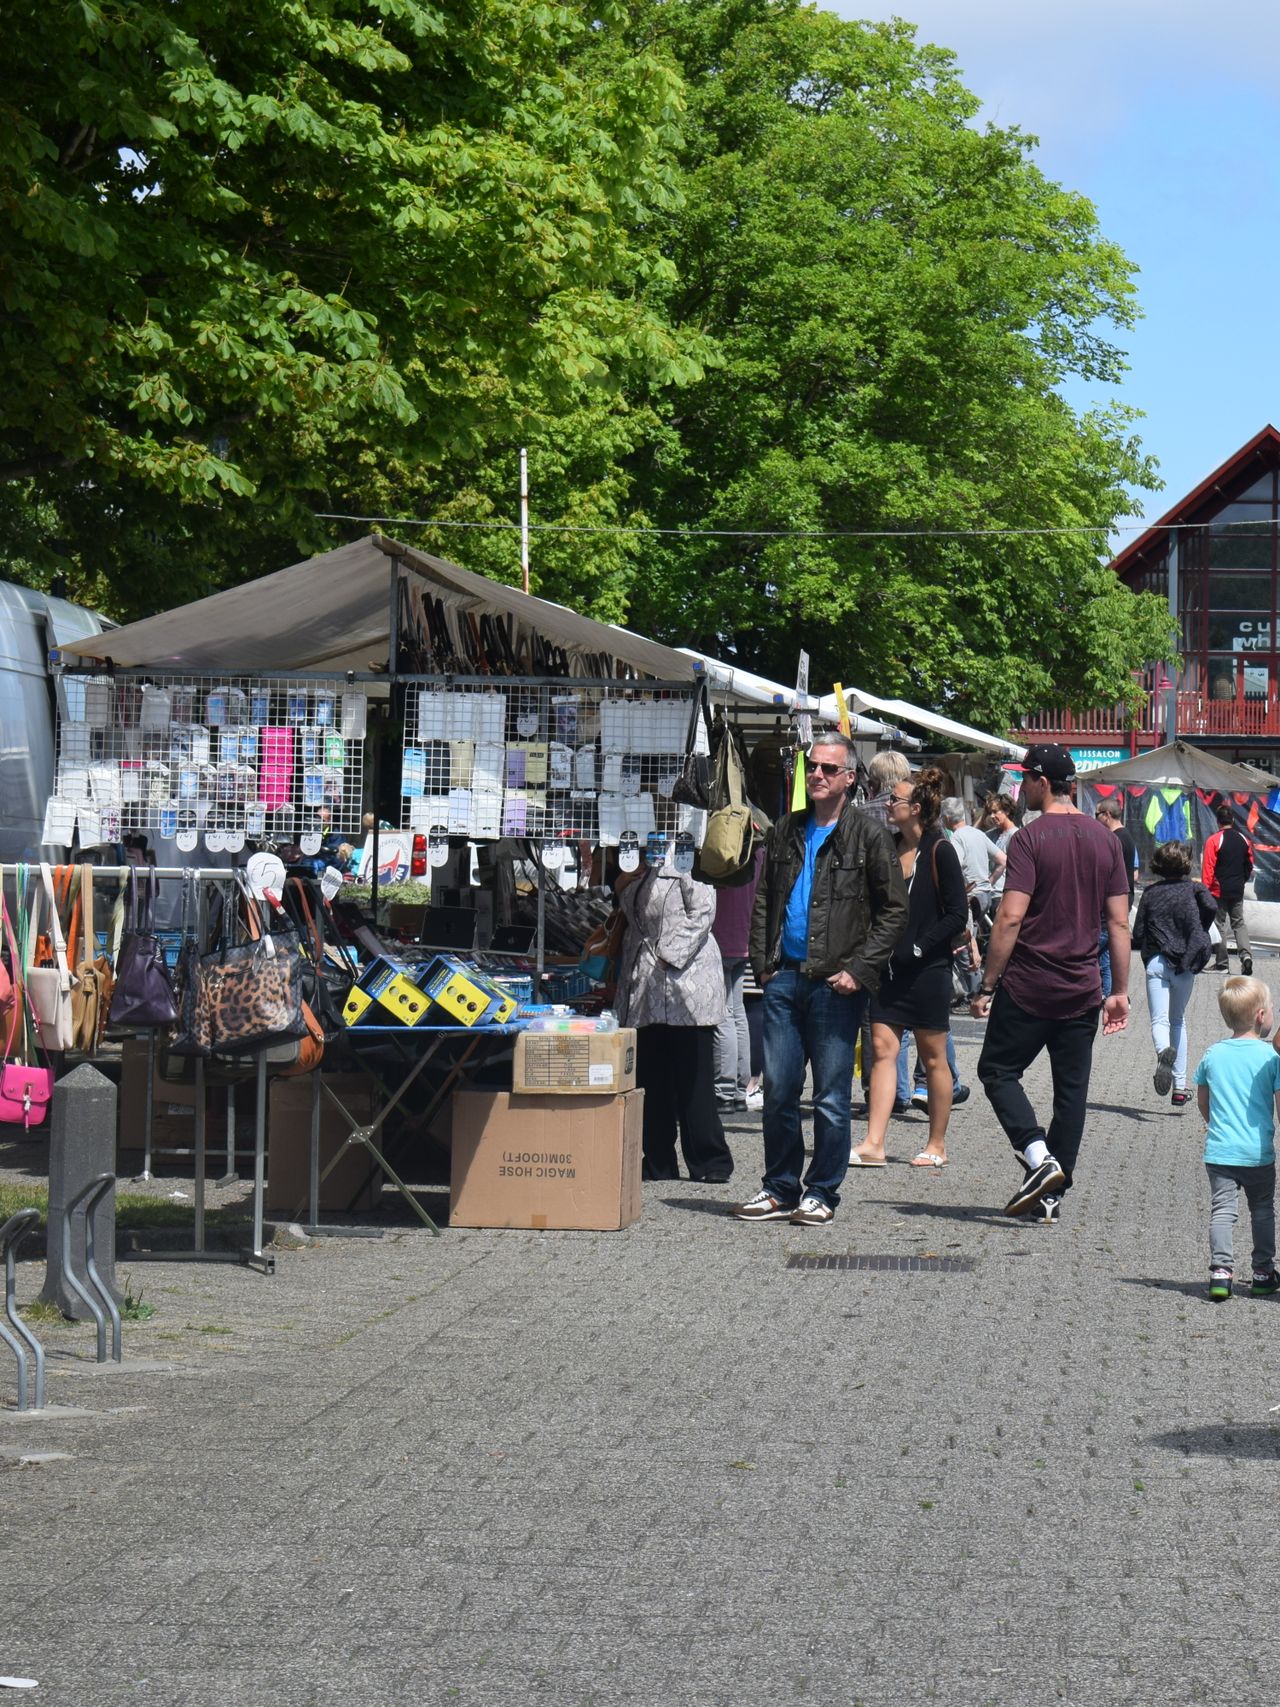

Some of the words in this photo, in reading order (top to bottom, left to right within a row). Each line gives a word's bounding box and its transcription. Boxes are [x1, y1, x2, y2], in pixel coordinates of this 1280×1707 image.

[1079, 750, 1120, 758] IJSSALON
[499, 1166, 533, 1177] HOSE
[536, 1168, 576, 1178] MAGIC
